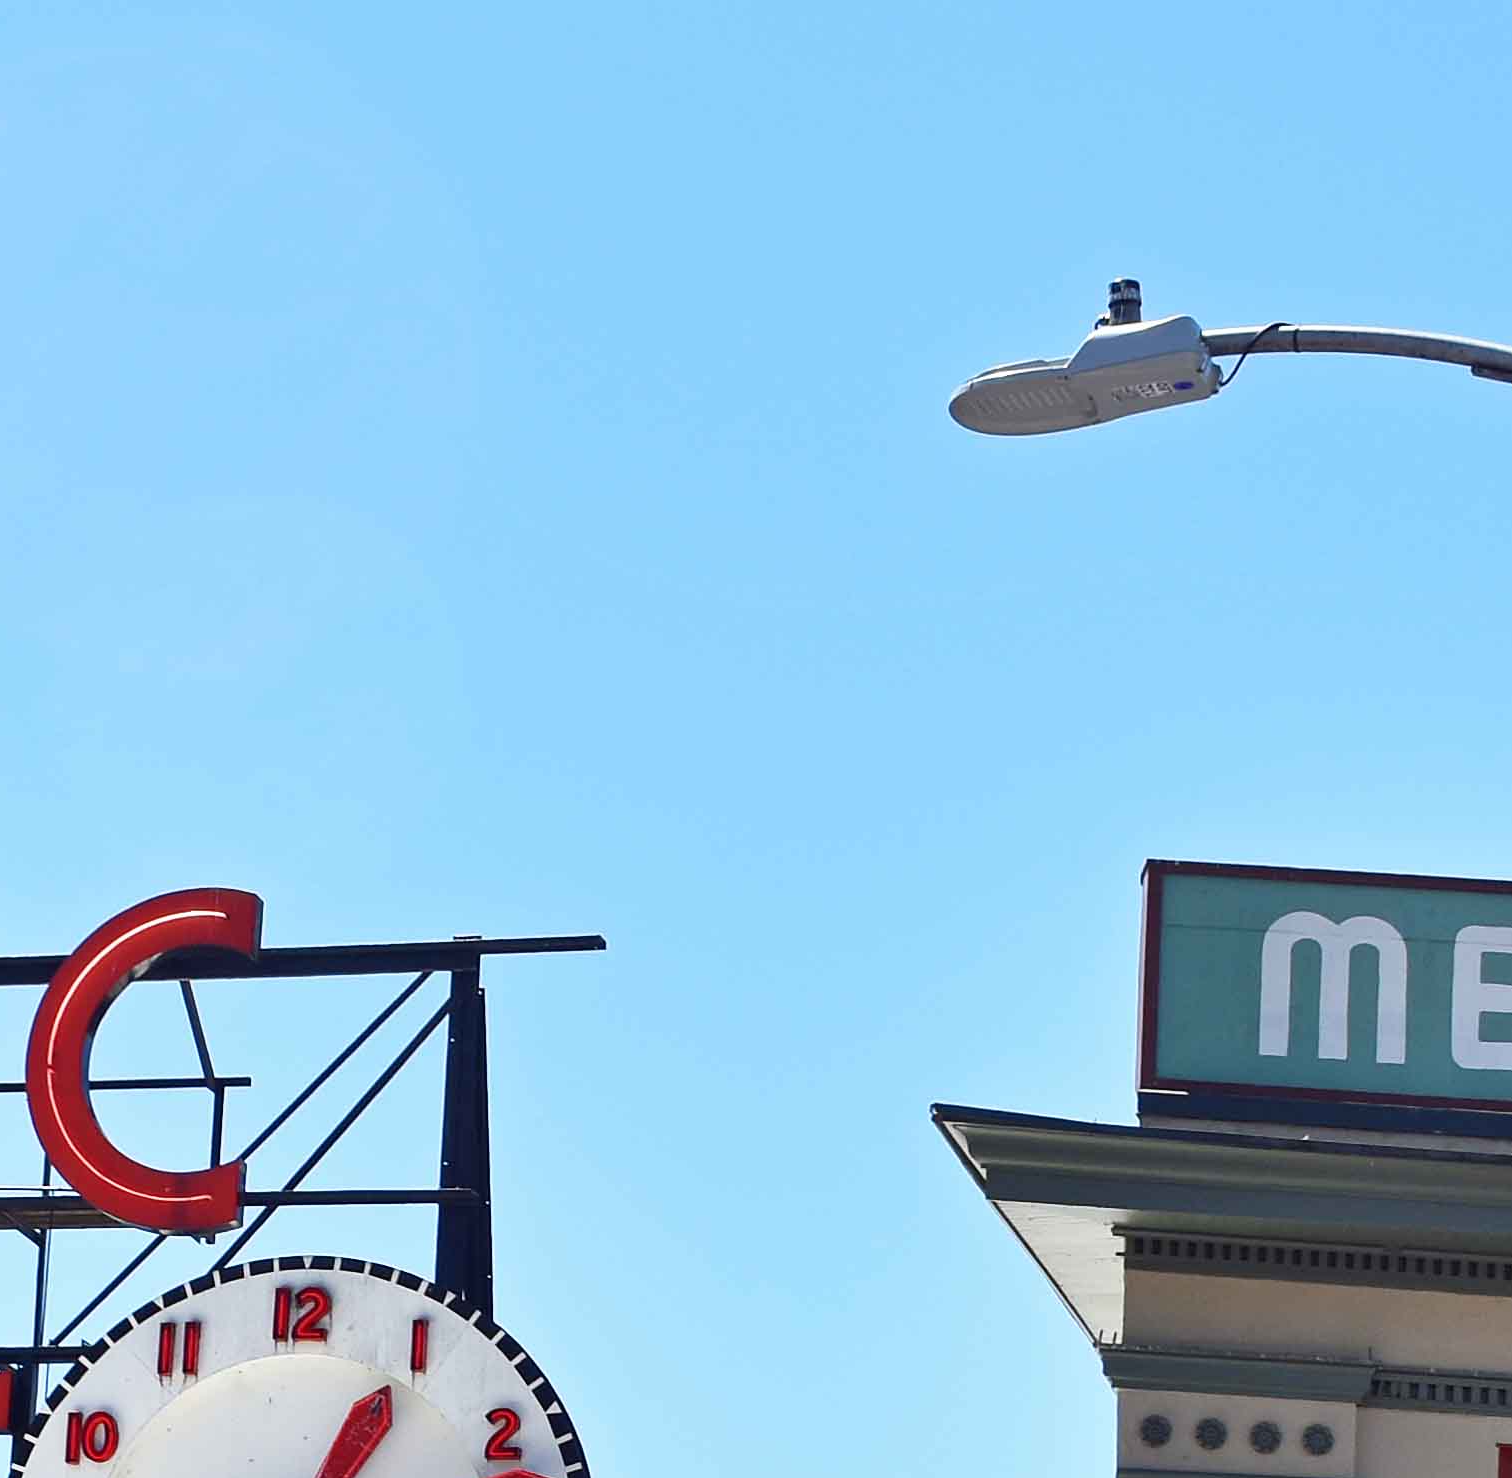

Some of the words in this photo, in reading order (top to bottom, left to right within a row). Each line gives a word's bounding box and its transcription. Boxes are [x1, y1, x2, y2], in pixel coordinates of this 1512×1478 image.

[273, 1287, 330, 1342] 12
[159, 1321, 200, 1377] 11
[410, 1318, 429, 1373] 1
[65, 1410, 118, 1466] 10
[485, 1409, 521, 1462] 2
